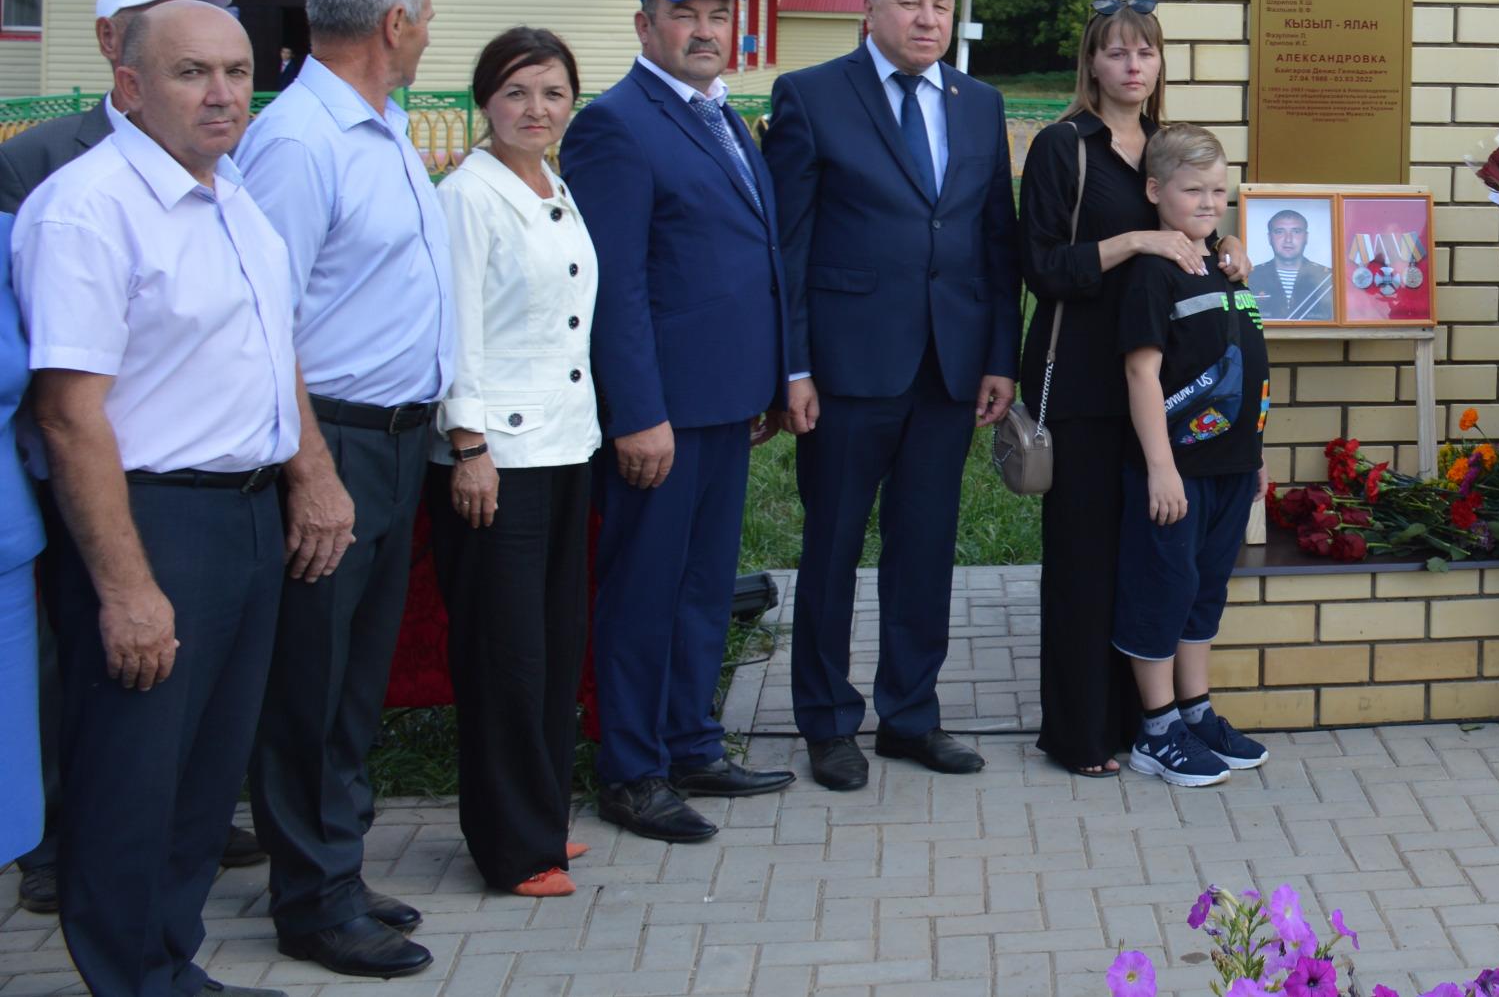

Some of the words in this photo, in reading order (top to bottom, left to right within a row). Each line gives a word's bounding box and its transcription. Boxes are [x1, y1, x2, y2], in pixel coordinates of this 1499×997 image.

[1284, 18, 1332, 30] КЫЗЫЛ
[1343, 19, 1379, 31] ЯЛАН
[1276, 53, 1387, 64] АЛЕКСАНДРОВКА
